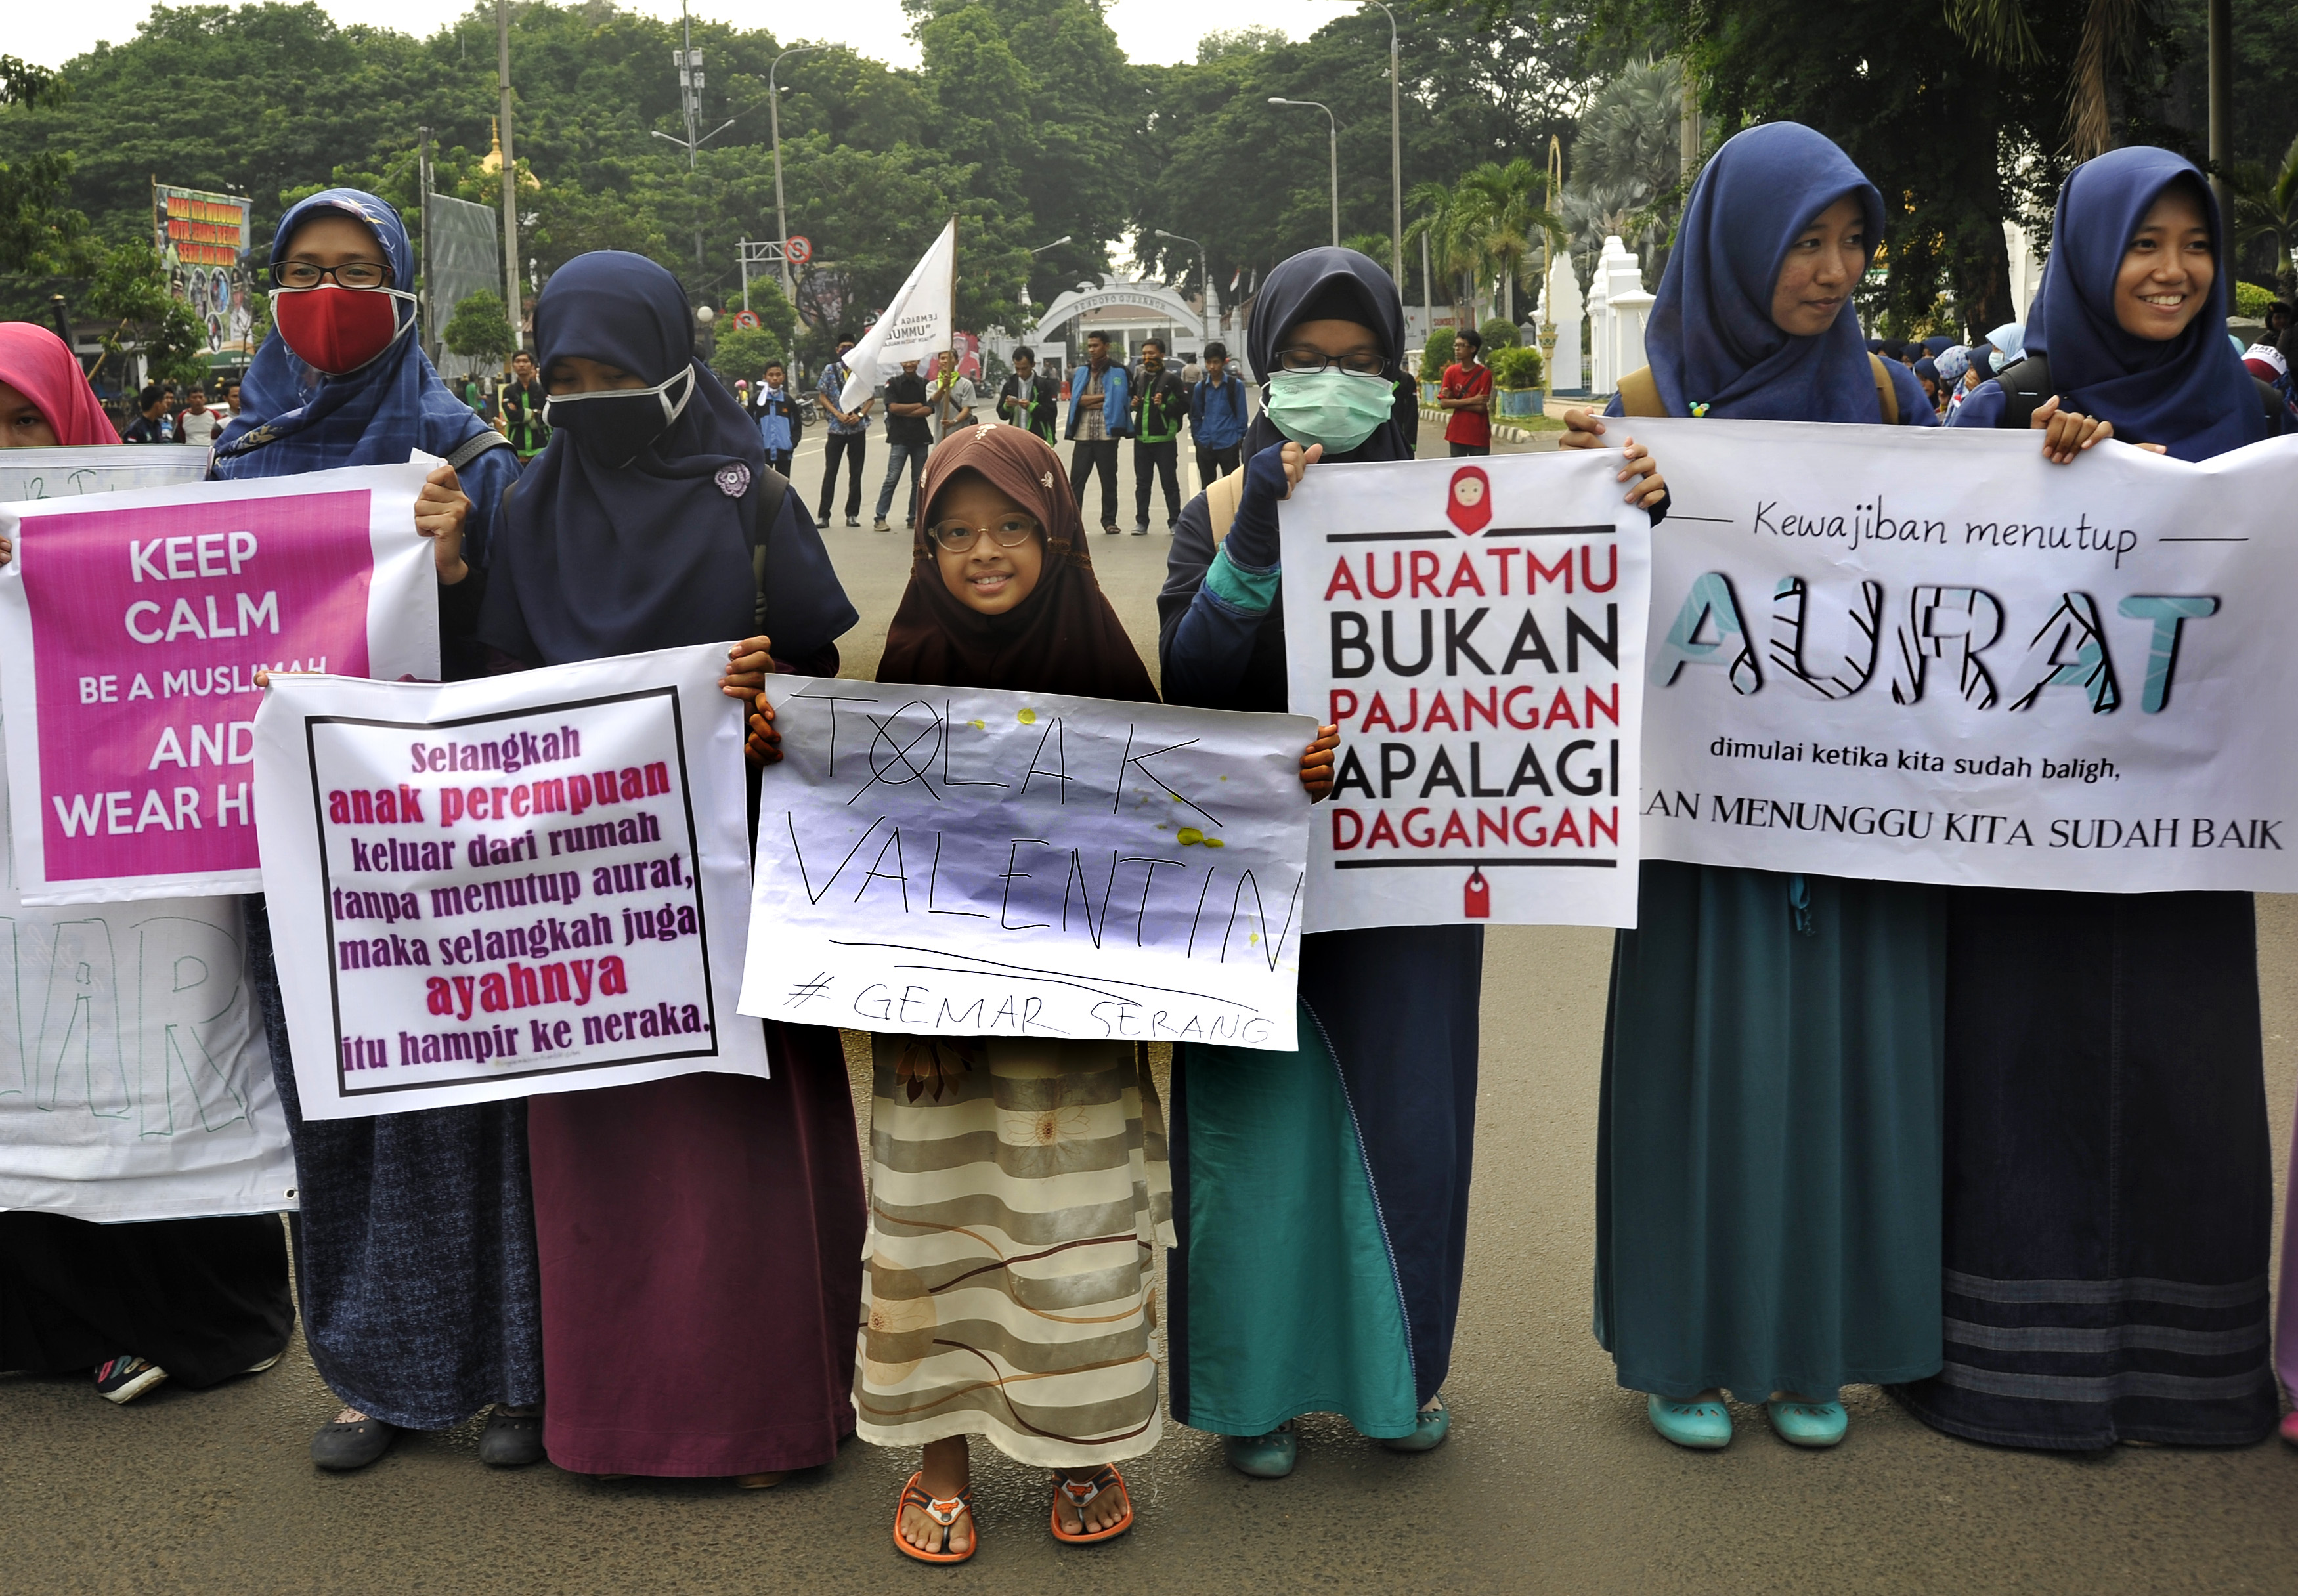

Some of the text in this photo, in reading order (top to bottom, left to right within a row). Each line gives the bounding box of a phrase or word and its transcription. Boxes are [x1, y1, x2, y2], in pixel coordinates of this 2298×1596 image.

[167, 196, 190, 218] MARI
[168, 219, 190, 240] KOTA
[191, 221, 216, 244] SERANG
[201, 244, 215, 265] DAN
[129, 531, 257, 583] KEEP
[1754, 496, 2137, 569] Kewajiban menutup
[1324, 544, 1618, 601] AURATMU
[125, 590, 280, 644] CALM
[1331, 603, 1619, 678] BUKAN
[1650, 572, 2221, 715] AURAT
[79, 674, 118, 704] BE
[128, 672, 154, 701] A
[1330, 683, 1618, 733] PAJANGAN
[148, 720, 255, 771] AND
[411, 726, 580, 774] Selangkah
[790, 693, 1223, 828] TOLAK
[1329, 739, 1618, 800] APALAGI
[1710, 736, 2121, 784] dimulai ketika kita sudah baligh,
[53, 787, 202, 838] WEAR
[328, 760, 670, 827] anak perempuan
[1639, 788, 2284, 850] AN MENUNGGU KITA SUDAH BAIK
[351, 812, 661, 872] keluar dari rumah
[1332, 806, 1618, 850] DAGANGAN
[333, 853, 694, 923] tanpa menutup aurat,
[788, 811, 1303, 972] VALENTIN
[339, 903, 697, 970] maka selangkah juga
[426, 955, 628, 1021] ayahnya
[854, 983, 1071, 1036] GEMAR
[1091, 1001, 1276, 1044] SERANG
[341, 1036, 388, 1071] itu
[399, 1023, 519, 1064] hampir
[531, 1018, 573, 1053] ke
[584, 1001, 712, 1045] neraka.
